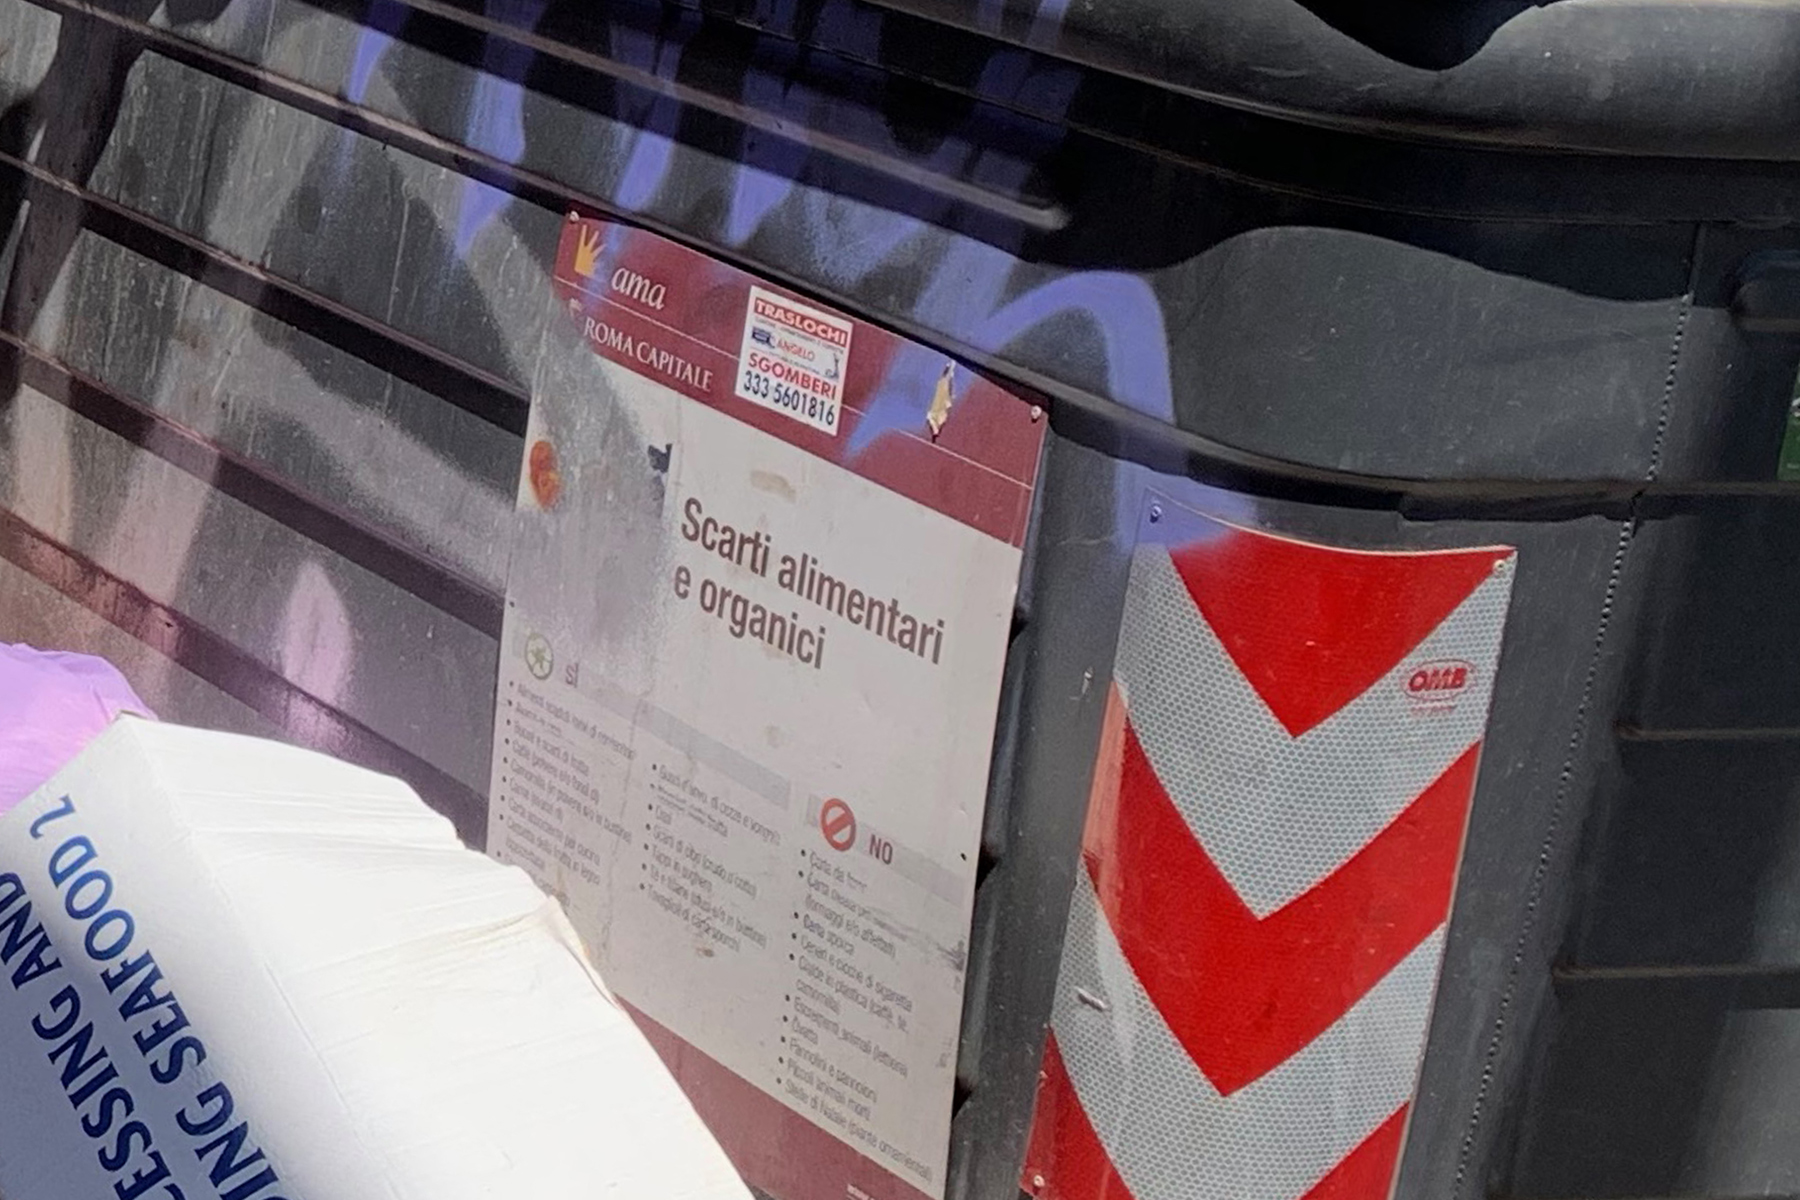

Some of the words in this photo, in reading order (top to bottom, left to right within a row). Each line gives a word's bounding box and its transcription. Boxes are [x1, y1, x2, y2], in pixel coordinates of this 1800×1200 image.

[612, 267, 666, 310] ama
[583, 316, 633, 356] ROMA
[636, 340, 713, 393] CAPITALE
[756, 300, 846, 345] TRASLOCHI
[744, 371, 769, 398] 333
[773, 383, 835, 426] 5601816
[748, 352, 837, 400] SGOMBERI
[681, 497, 771, 577] Scarti
[777, 553, 945, 665] alimentari
[674, 565, 691, 600] e
[700, 578, 826, 669] organici
[1408, 667, 1468, 692] OMB
[869, 833, 893, 865] NO
[48, 835, 206, 1085] SEAFOOD
[31, 983, 186, 1200] ESSING
[175, 1081, 288, 1200] ING
